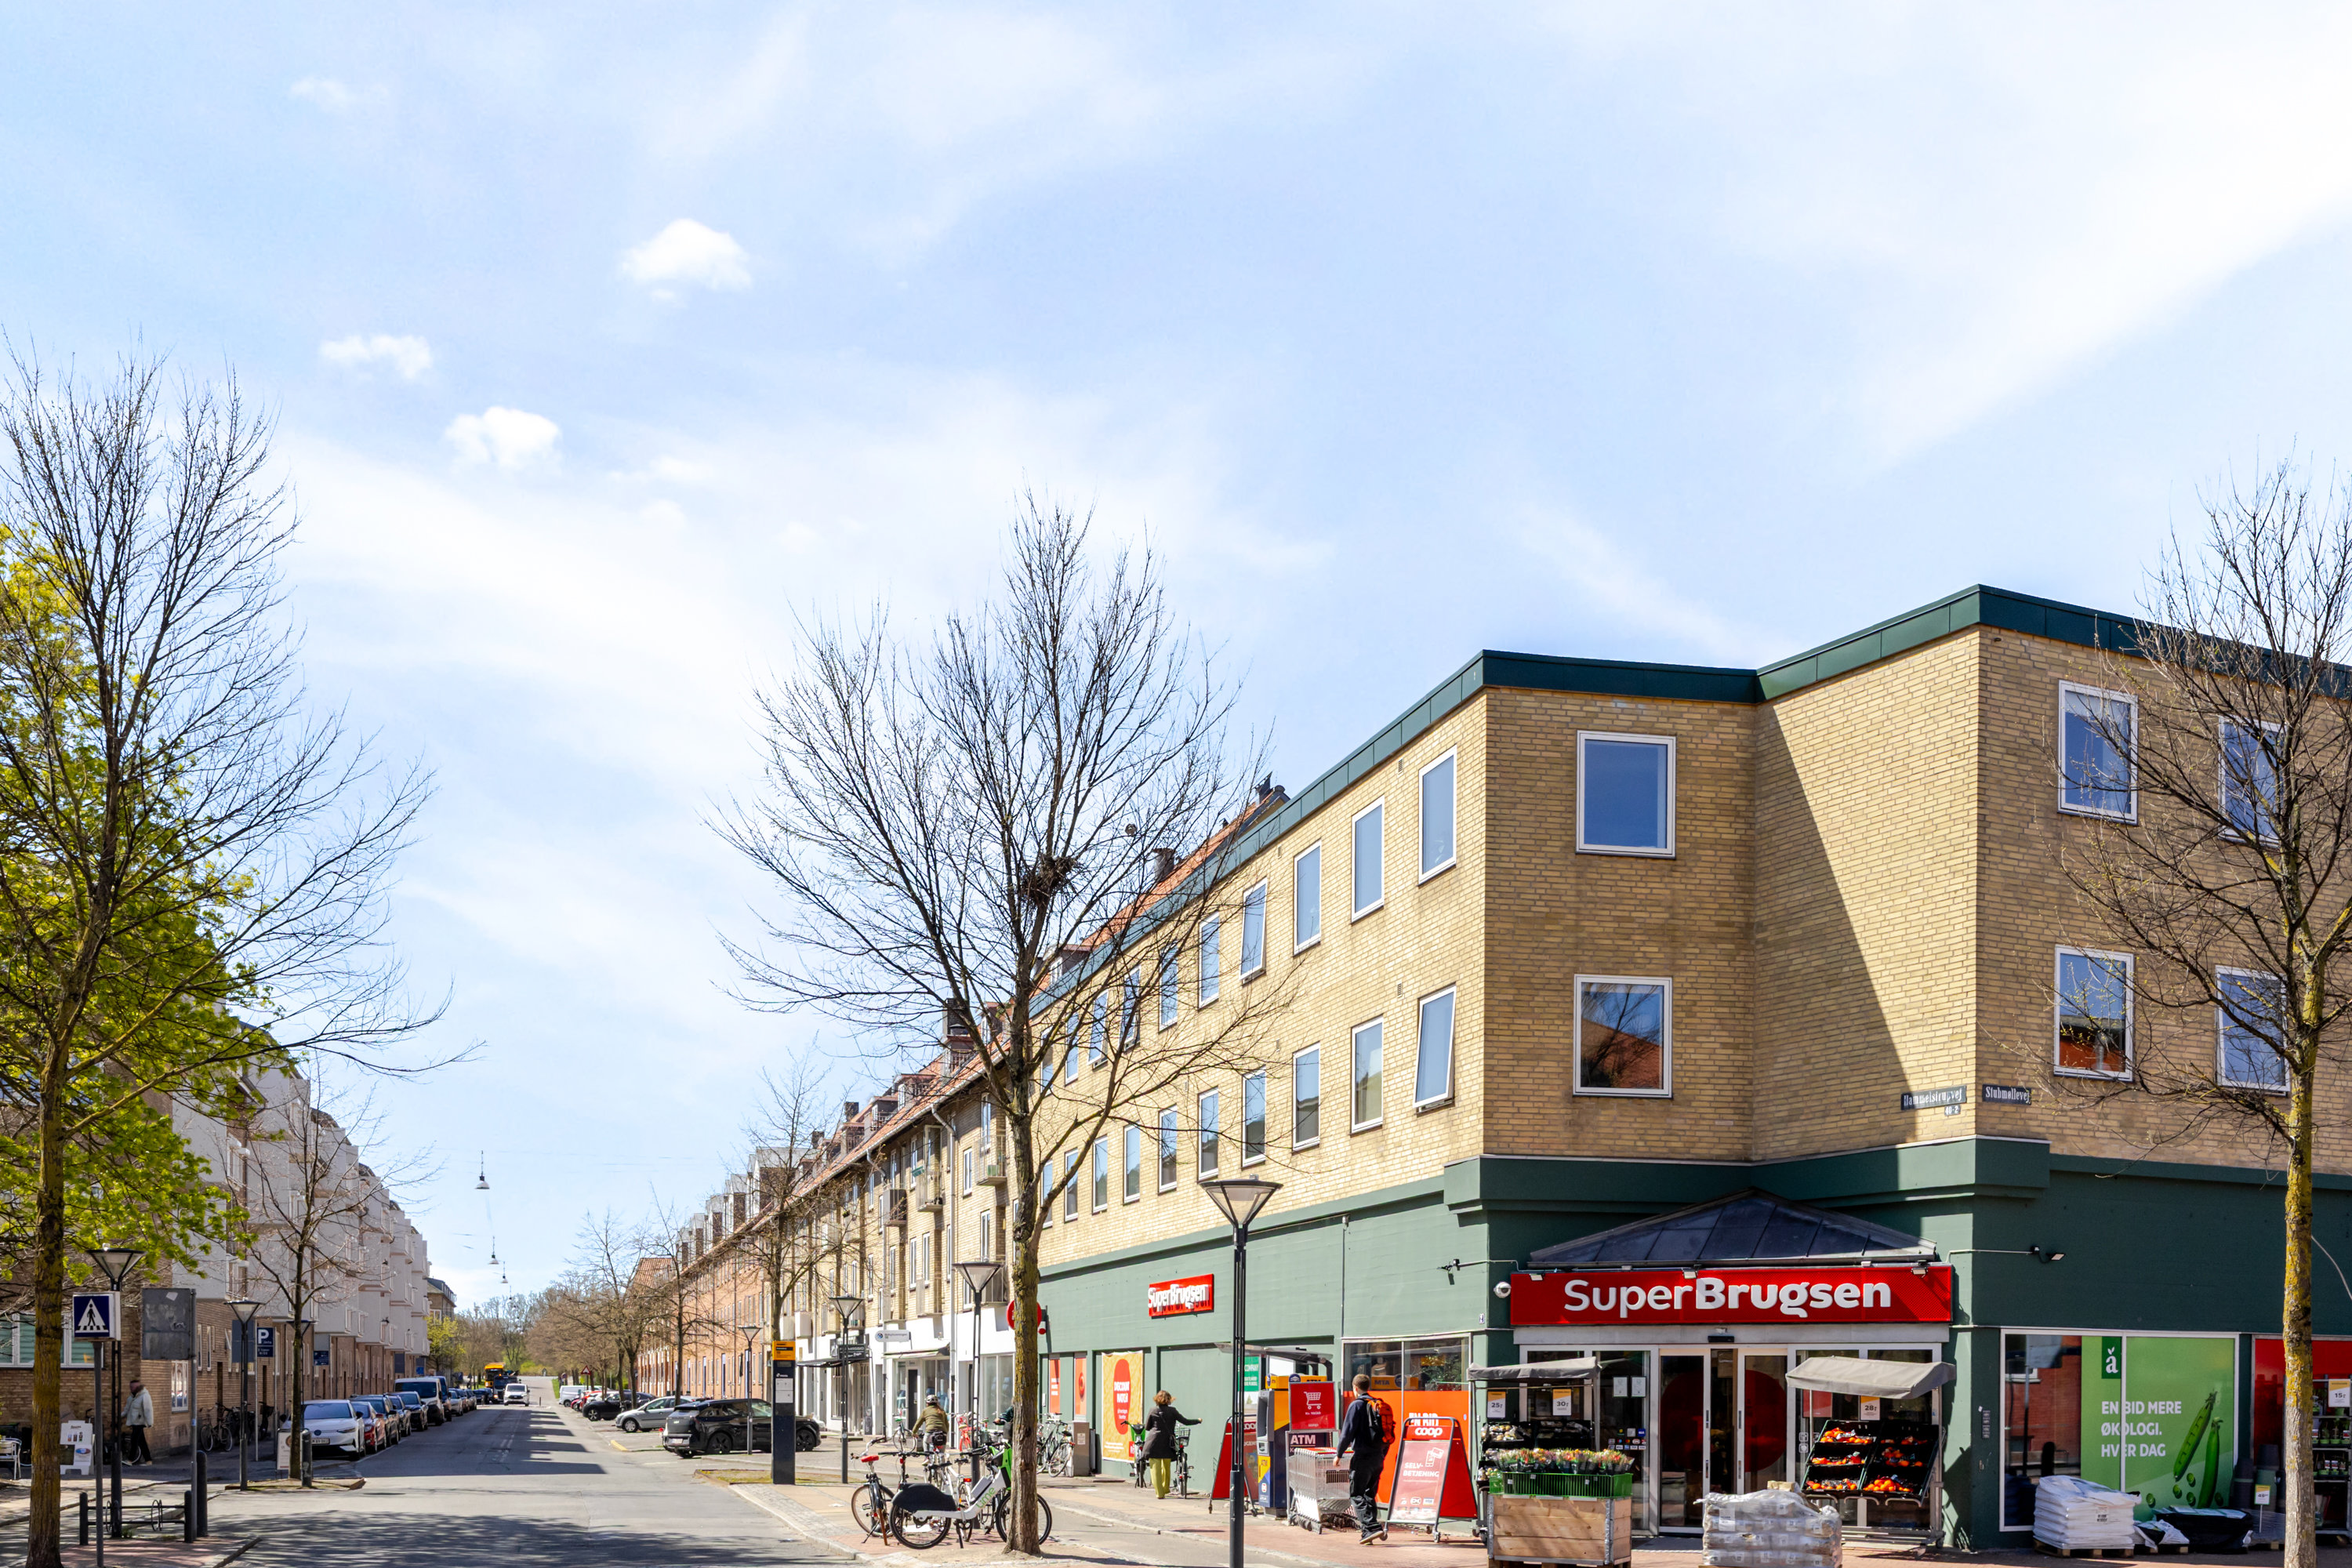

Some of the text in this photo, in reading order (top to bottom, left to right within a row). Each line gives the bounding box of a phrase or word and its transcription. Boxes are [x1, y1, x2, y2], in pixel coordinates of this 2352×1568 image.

[1148, 1284, 1209, 1312] SuperBrugsen
[1564, 1277, 1892, 1318] SuperBrugsen
[258, 1329, 269, 1344] P
[2102, 1401, 2182, 1414] EN BID MERE
[1415, 1428, 1443, 1437] coop
[1290, 1435, 1316, 1444] ATM
[2140, 1444, 2166, 1457] DAG
